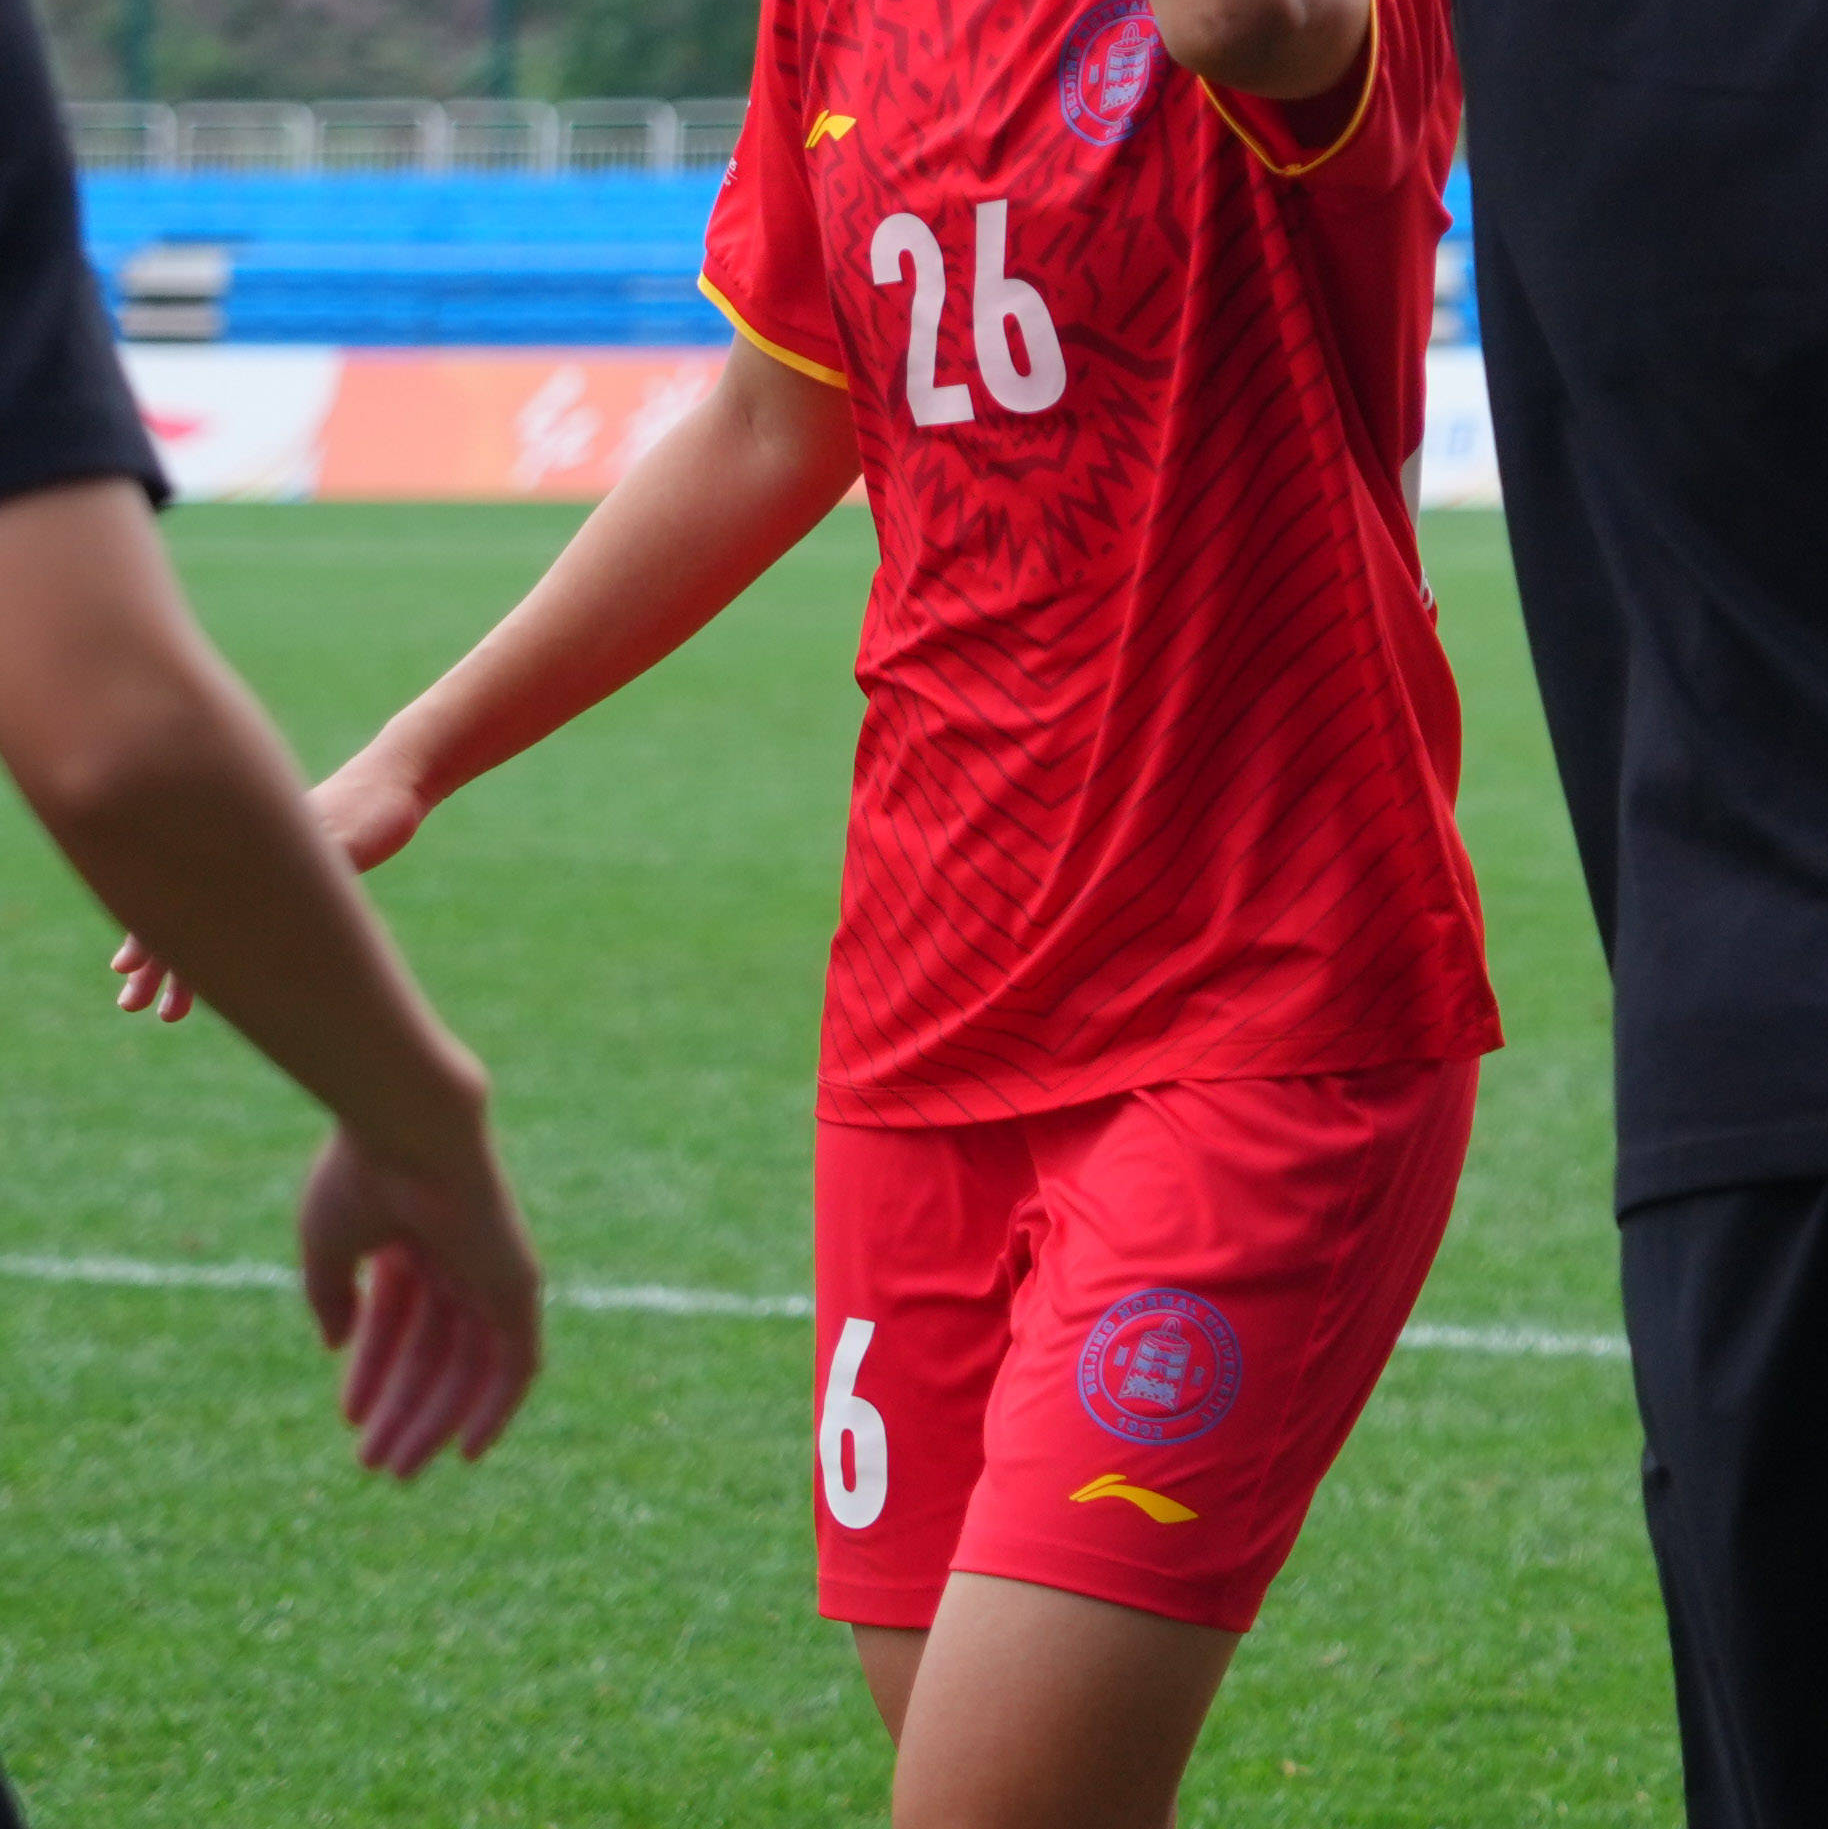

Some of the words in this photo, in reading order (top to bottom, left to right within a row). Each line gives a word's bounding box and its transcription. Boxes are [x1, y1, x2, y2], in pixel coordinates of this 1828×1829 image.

[870, 198, 1067, 427] 26
[1084, 1319, 1116, 1396] BEIJING
[1116, 1295, 1198, 1320] NORMAL
